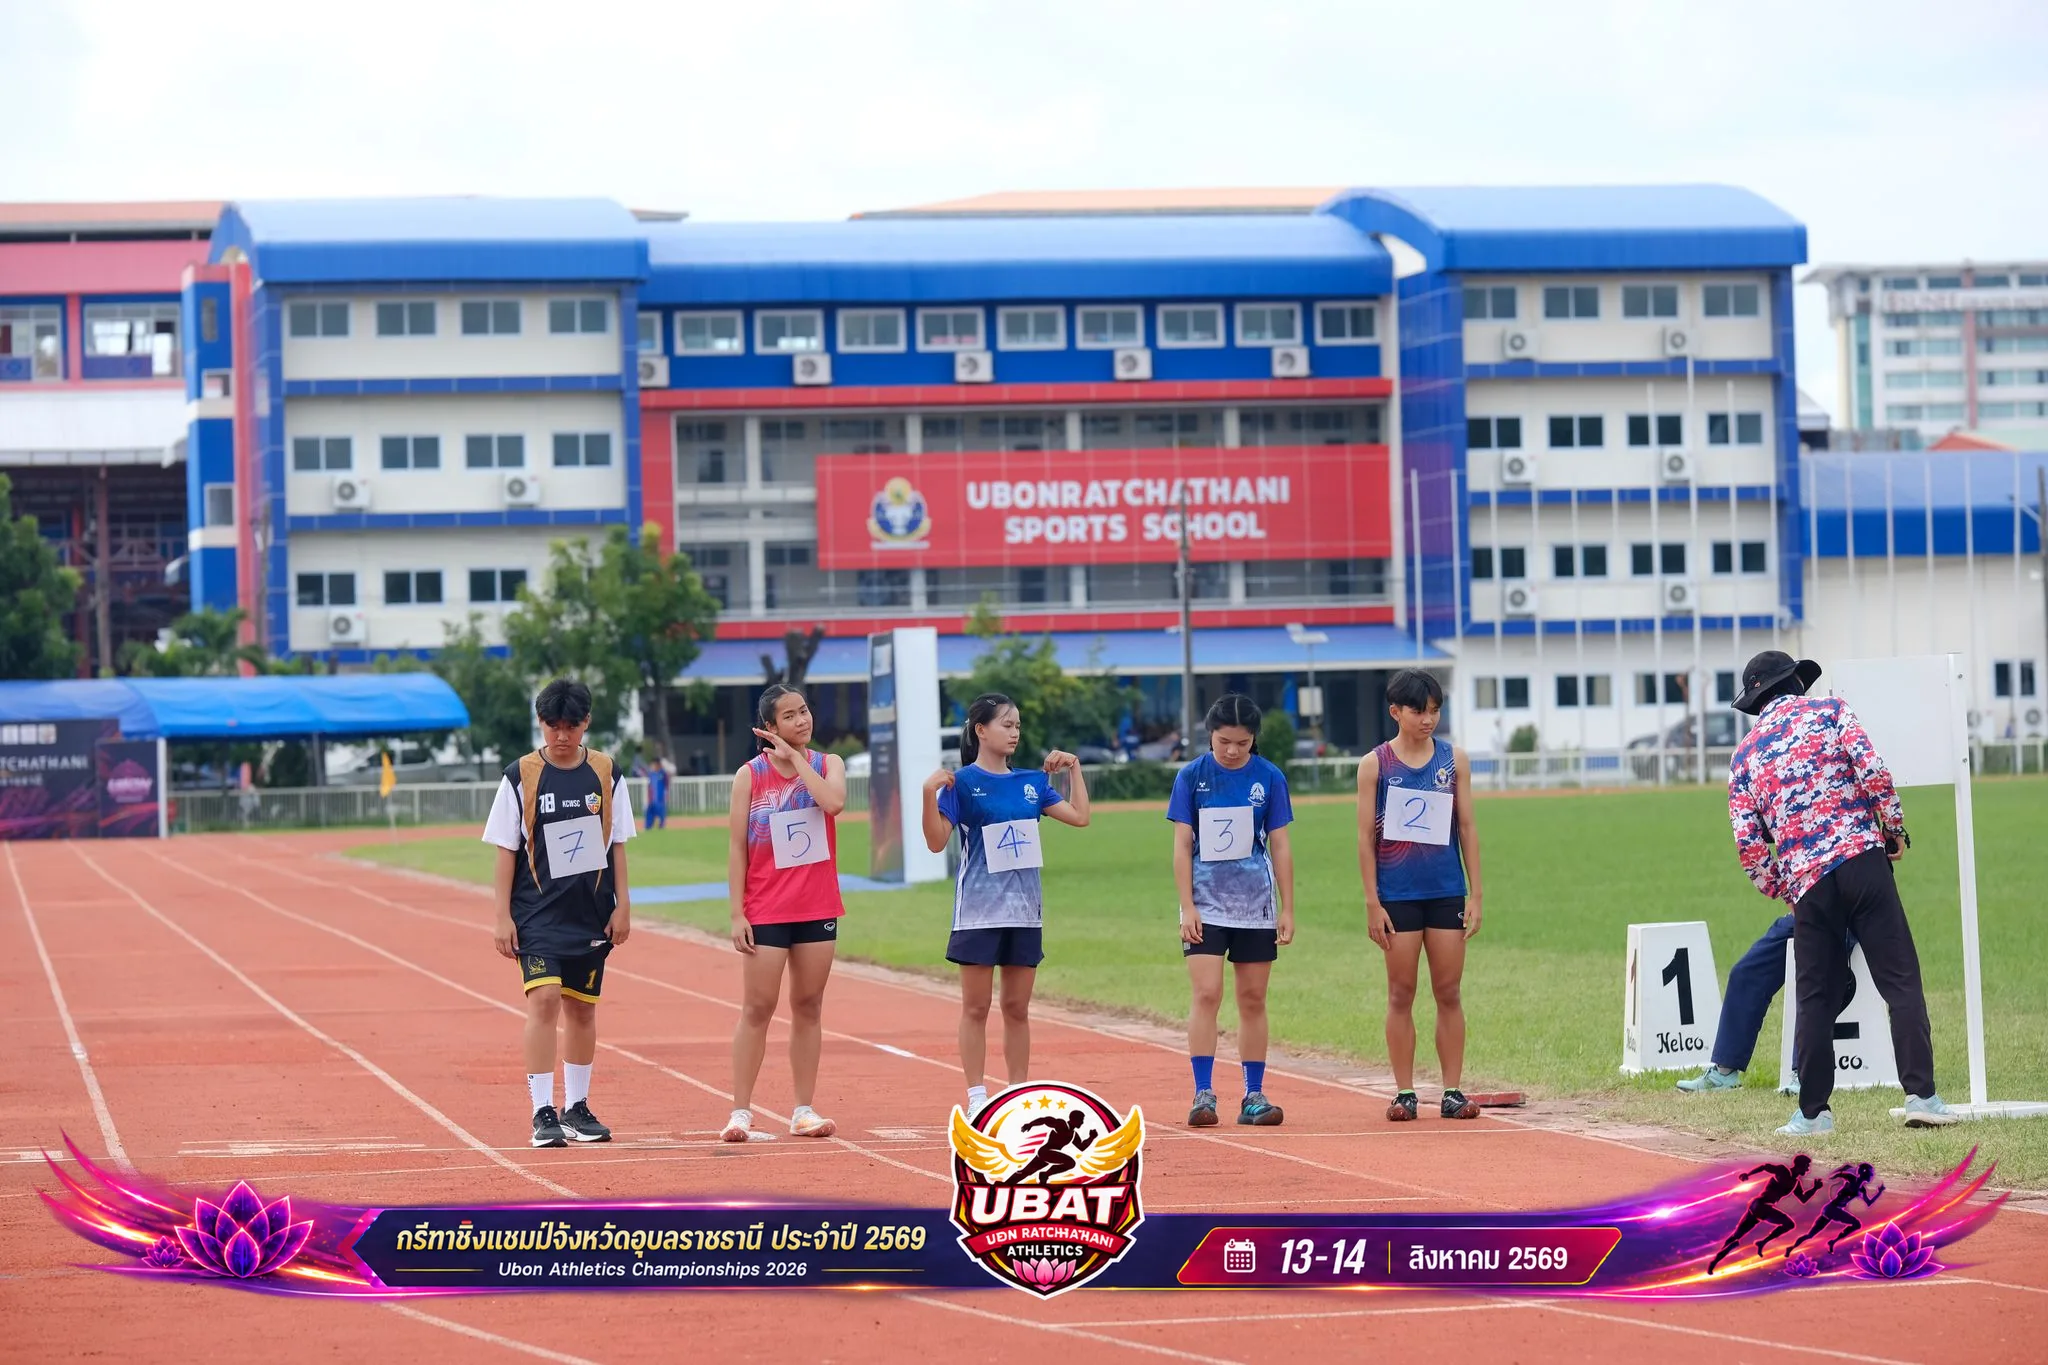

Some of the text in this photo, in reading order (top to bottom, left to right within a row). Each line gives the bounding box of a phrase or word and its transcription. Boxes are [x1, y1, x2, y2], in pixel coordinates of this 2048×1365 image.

[966, 476, 1290, 509] UBONRATCHATHANI
[1005, 511, 1266, 544] SPORTS SCHOOL
[1403, 797, 1431, 830] 2
[558, 830, 584, 863] 7
[786, 821, 811, 858] 5
[997, 824, 1031, 858] 4
[1213, 819, 1234, 853] 3
[585, 969, 597, 989] 1
[1662, 947, 1694, 1025] 1
[1656, 1031, 1704, 1054] Nelco
